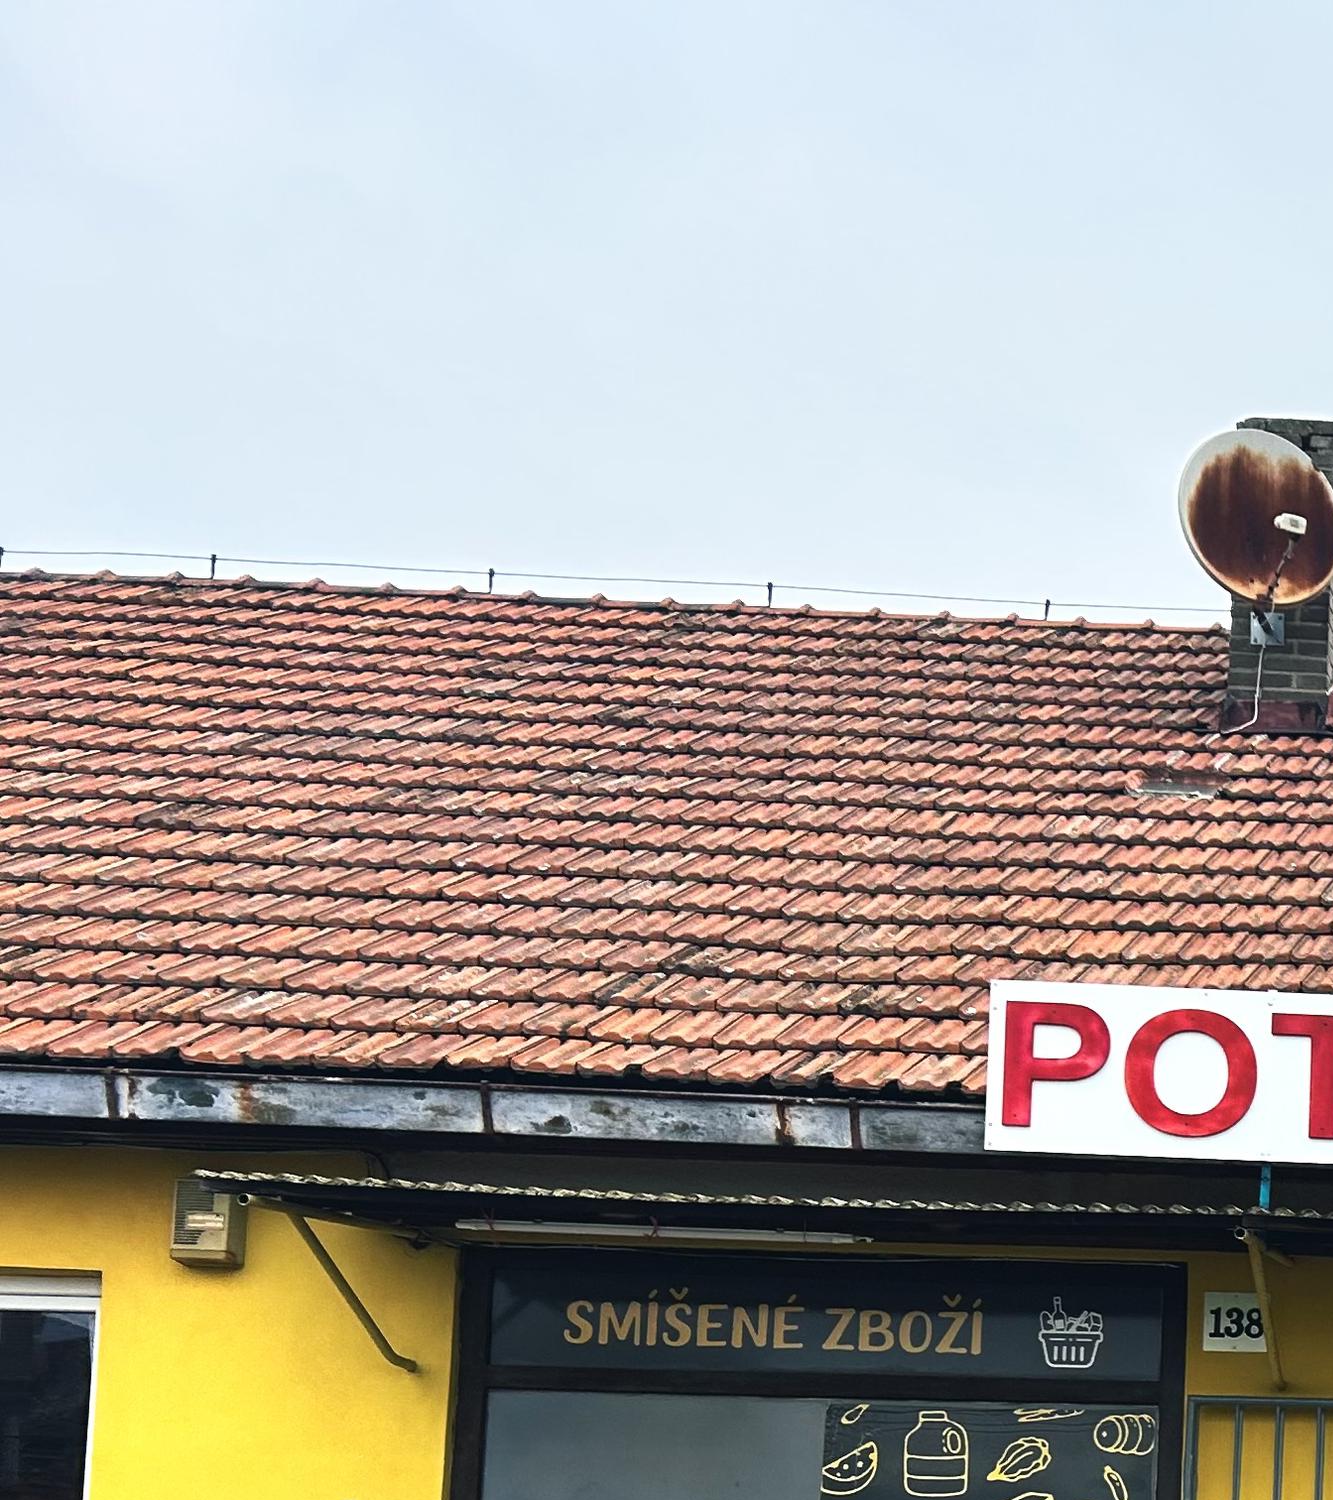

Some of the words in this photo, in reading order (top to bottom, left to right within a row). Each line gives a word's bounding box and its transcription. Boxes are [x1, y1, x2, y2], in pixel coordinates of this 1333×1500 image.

[563, 1286, 804, 1351] SMÍŠENÉ
[821, 1294, 984, 1356] ZBOŽÍ
[1207, 1306, 1265, 1340] 138
